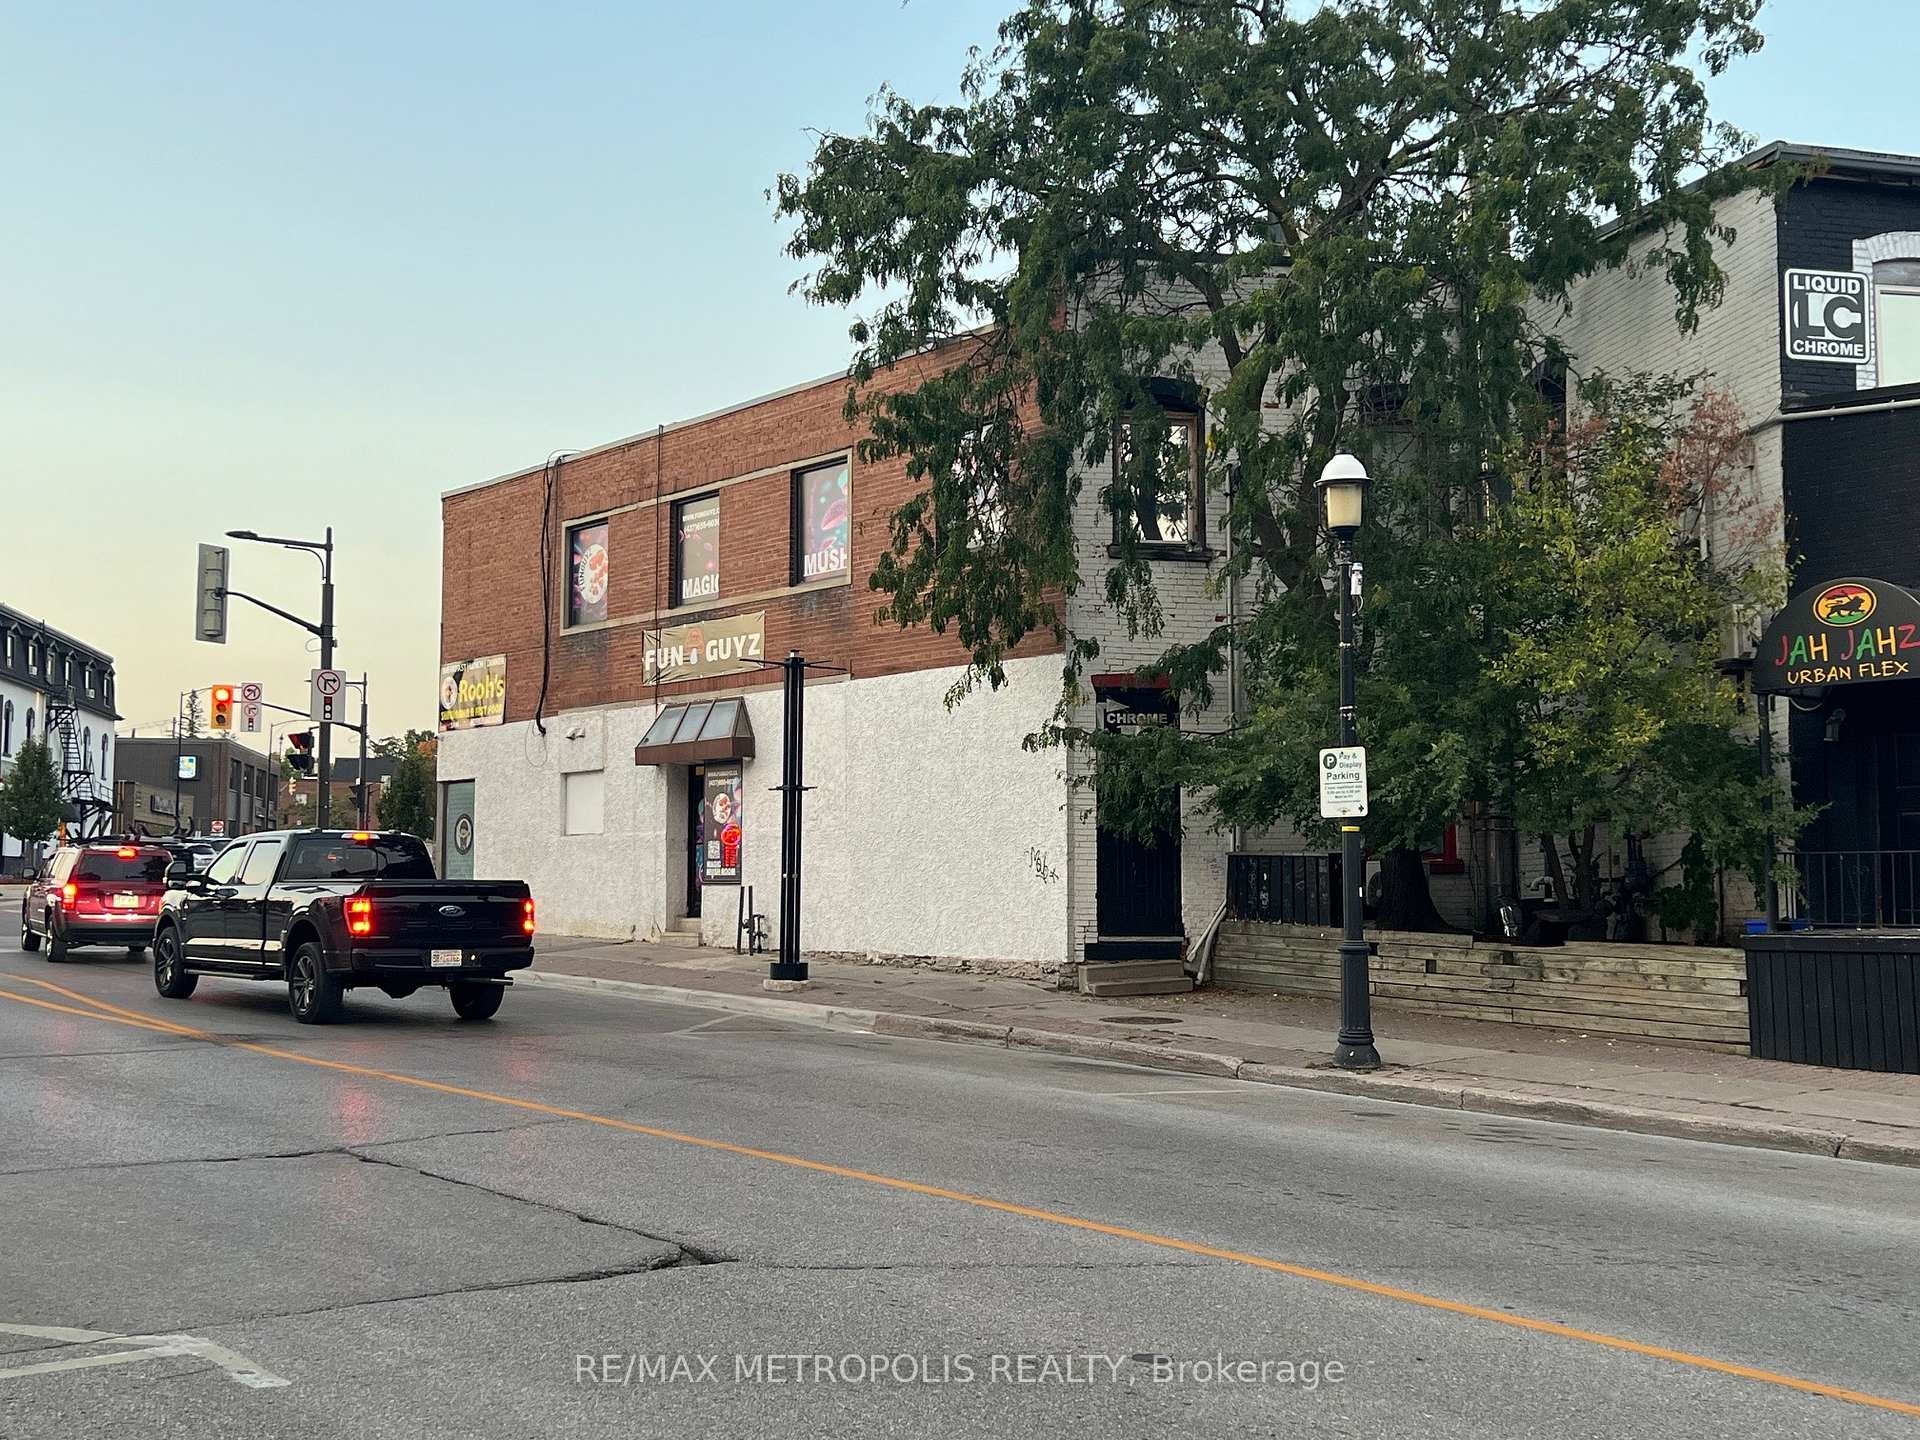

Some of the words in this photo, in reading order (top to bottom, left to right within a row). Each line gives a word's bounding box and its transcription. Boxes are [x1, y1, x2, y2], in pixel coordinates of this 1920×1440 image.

[1793, 275, 1861, 294] LIQUID
[1793, 339, 1864, 357] CHROME
[645, 645, 684, 671] FUN
[705, 633, 761, 662] GUYZ
[1775, 633, 1829, 666] JAH
[1840, 623, 1920, 661] JAHZ
[1787, 666, 1852, 685] URBAN
[1858, 660, 1909, 678] FLEX
[458, 674, 504, 702] Rooh's
[1106, 713, 1168, 724] CHROME
[1326, 771, 1360, 781] Parking
